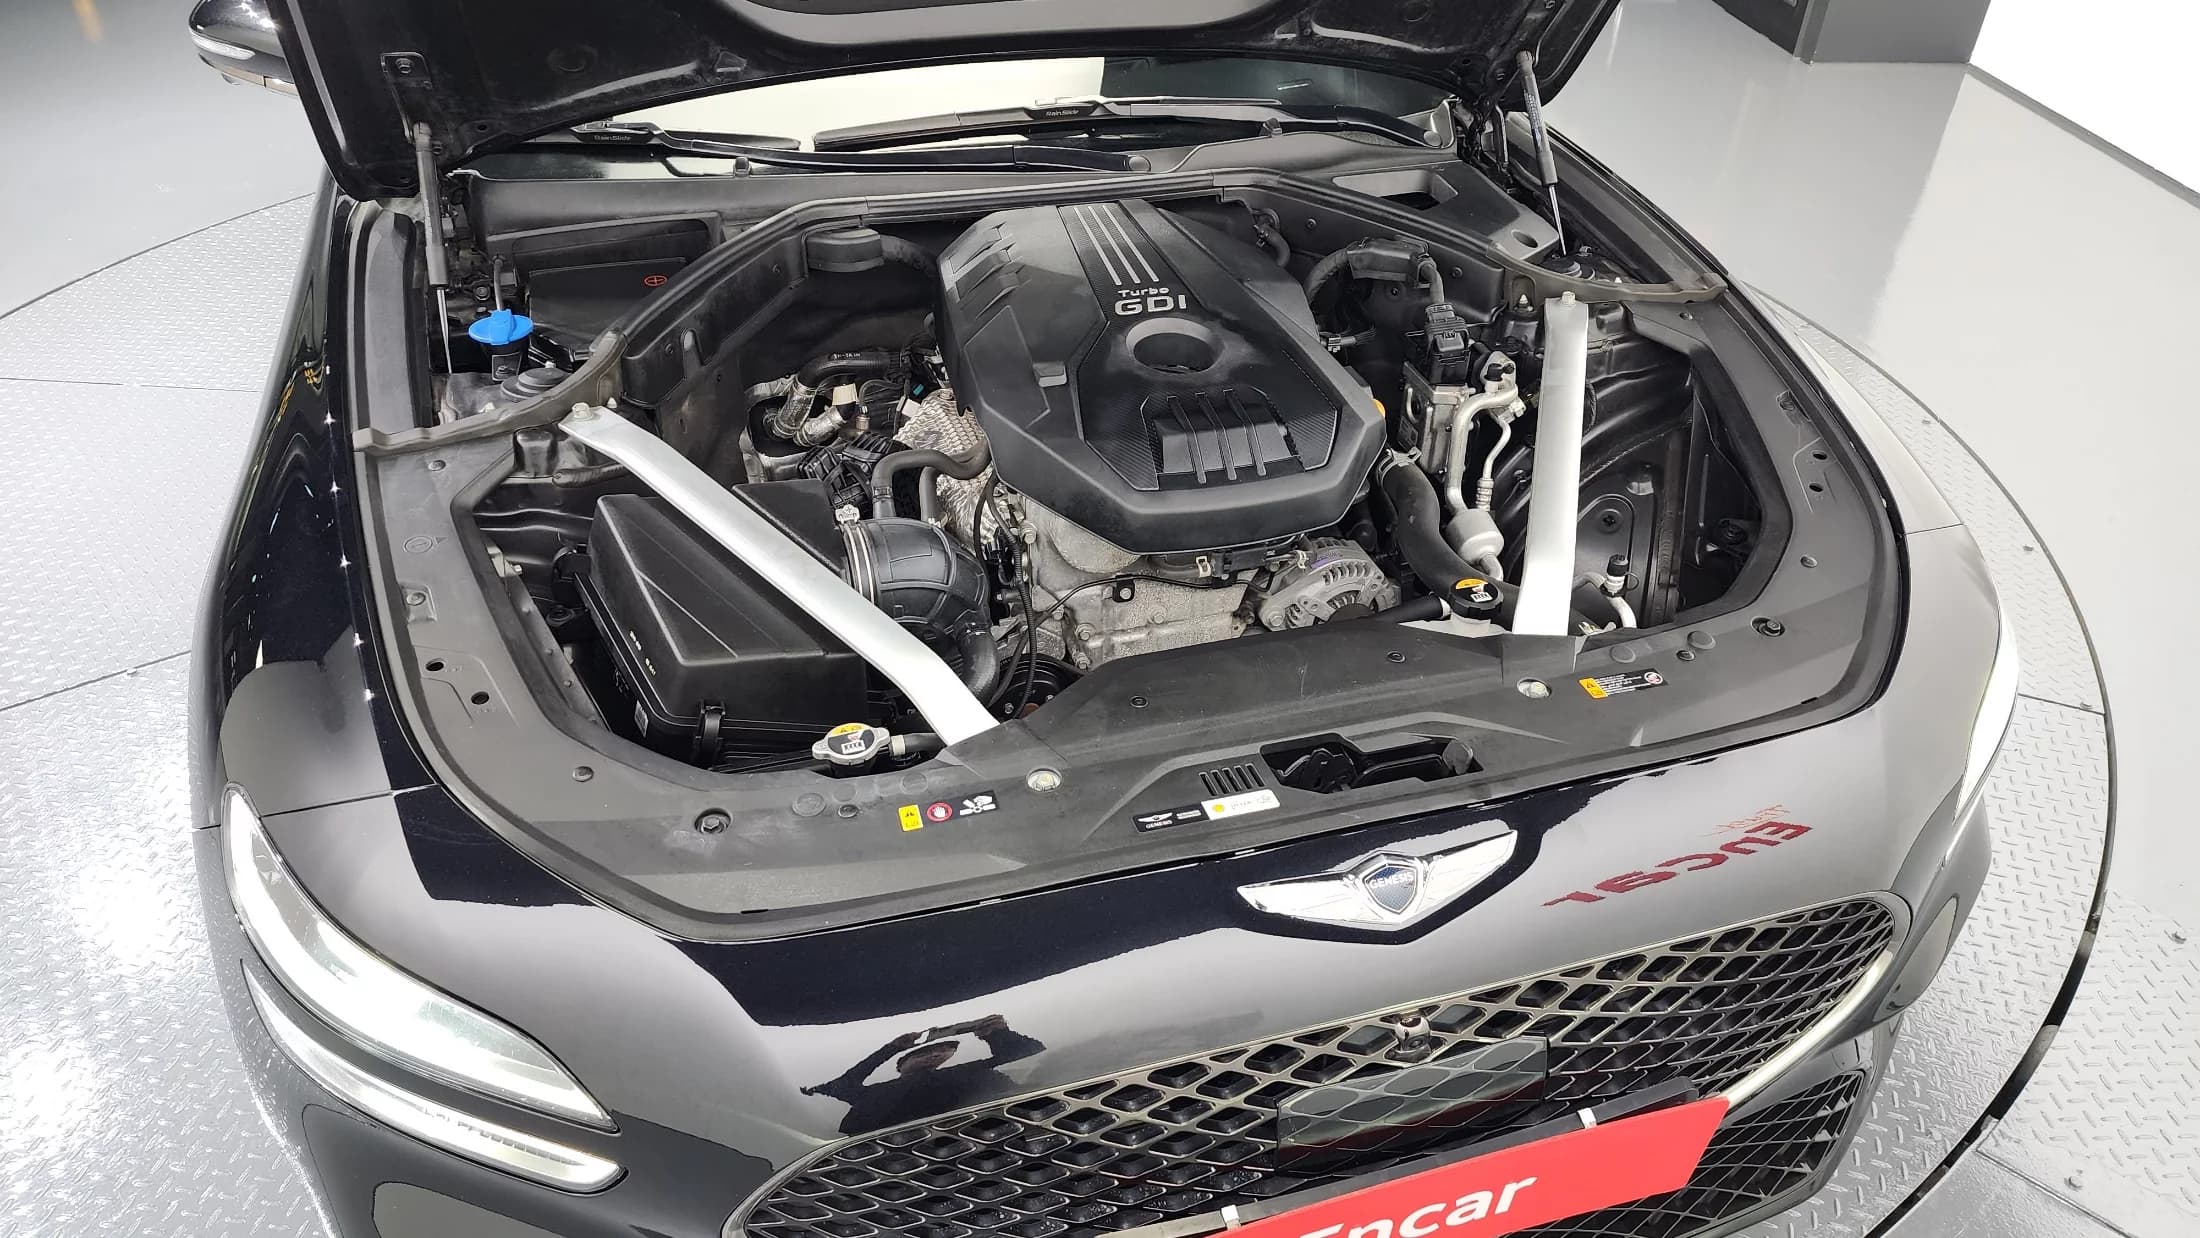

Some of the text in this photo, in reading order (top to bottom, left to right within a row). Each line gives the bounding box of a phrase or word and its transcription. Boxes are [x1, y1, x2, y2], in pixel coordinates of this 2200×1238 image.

[1118, 287, 1170, 297] Turbo
[1115, 295, 1187, 315] GDI
[1369, 871, 1415, 889] GENESIS
[1299, 1176, 1538, 1238] ncar
